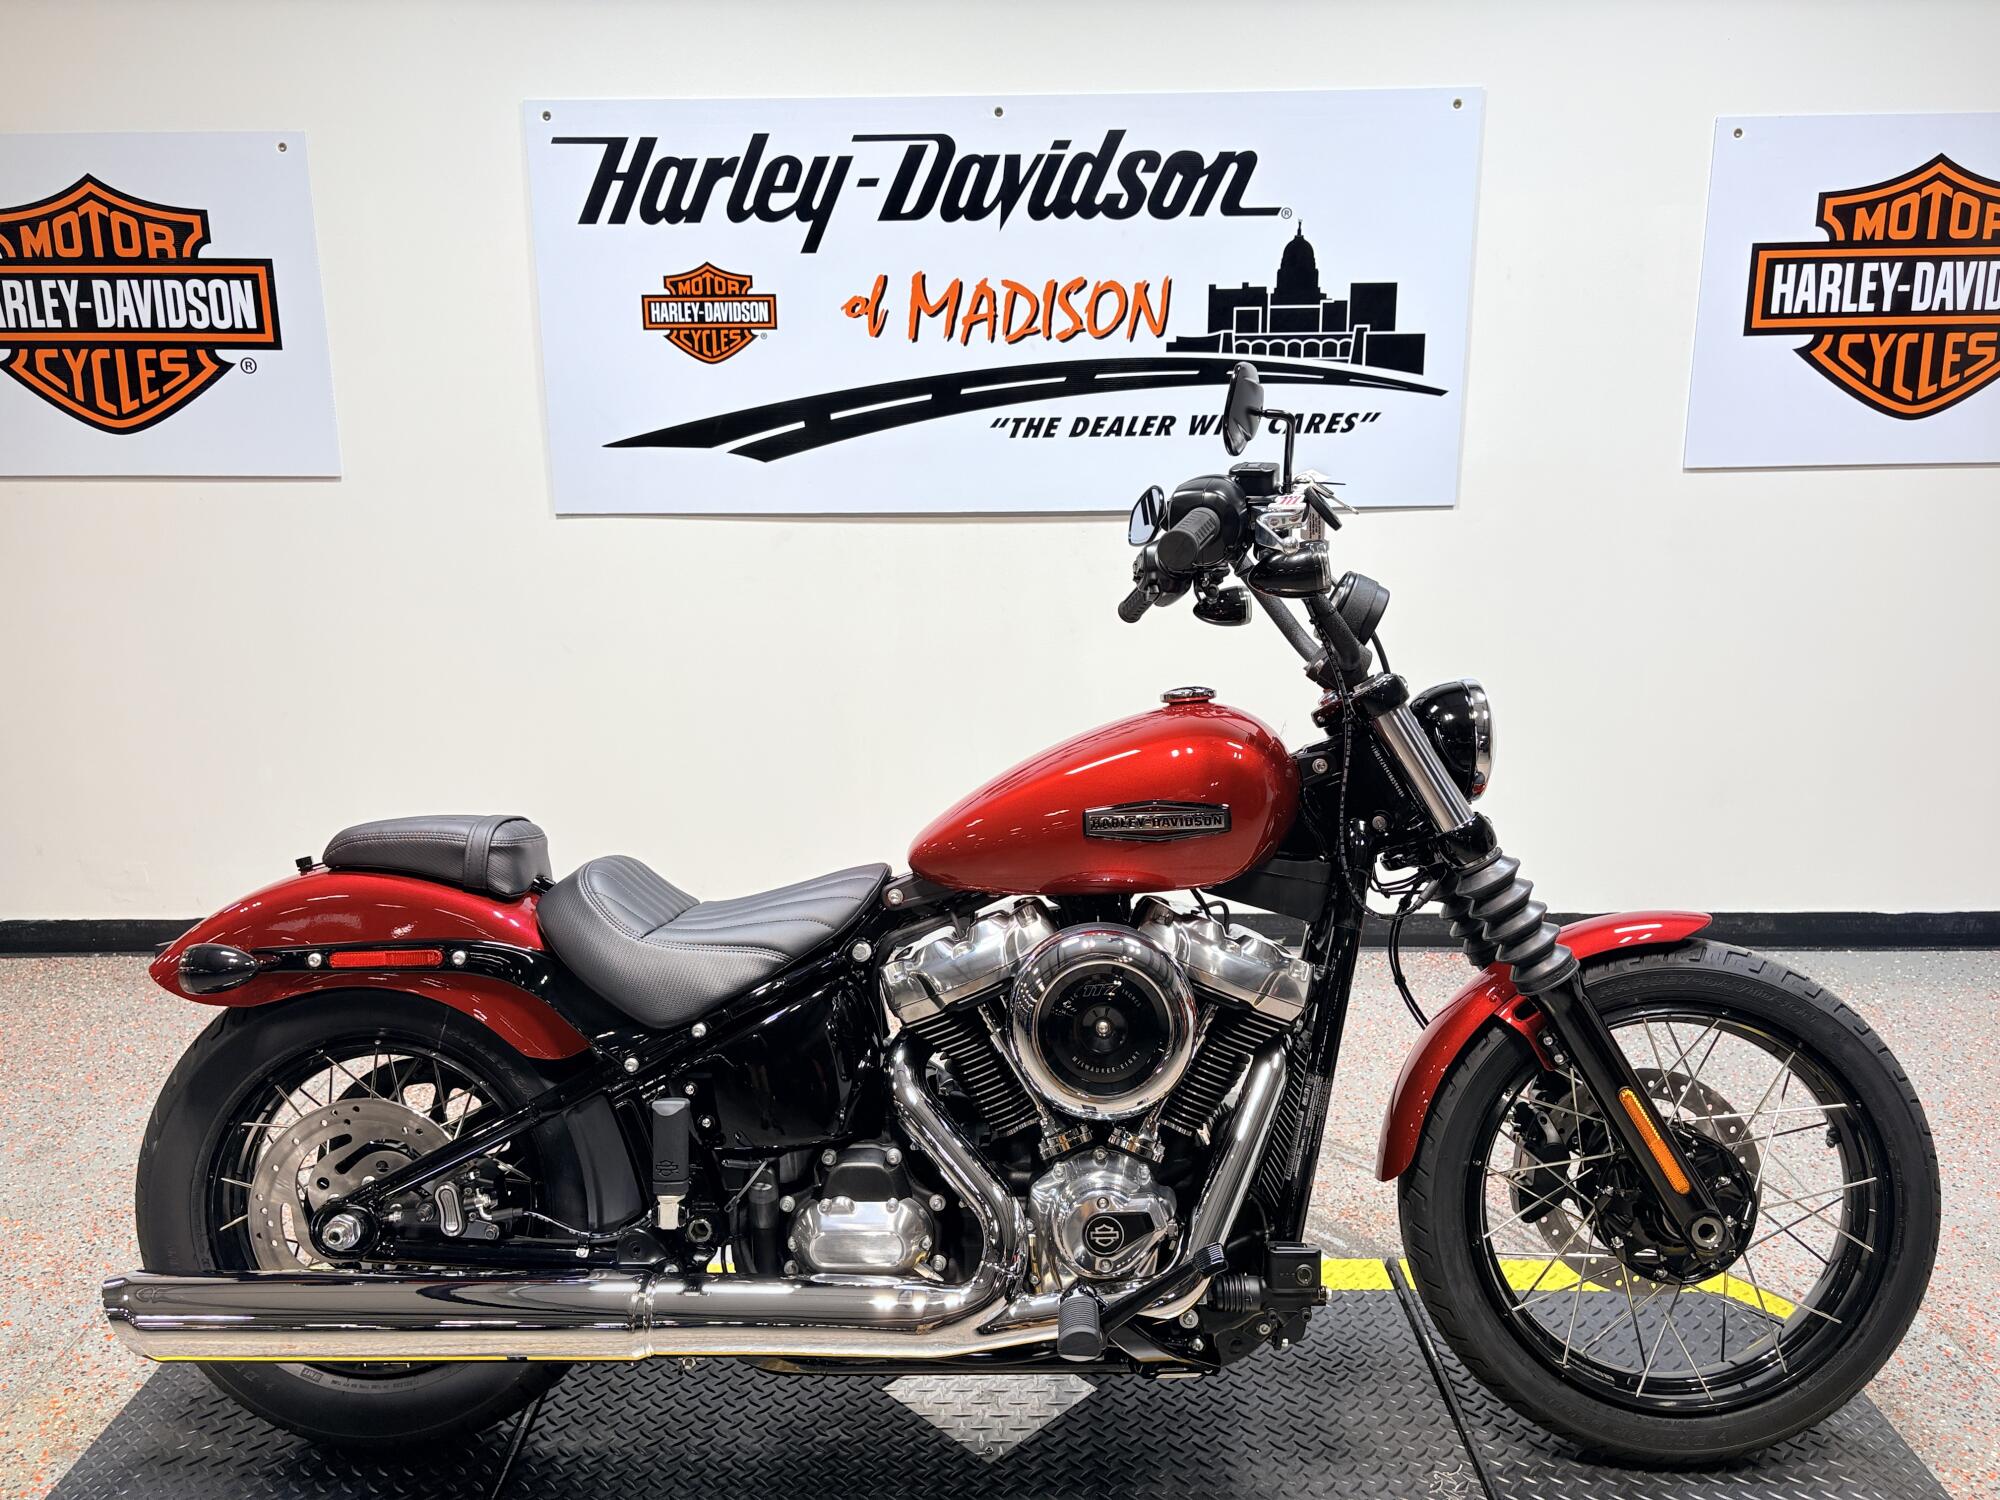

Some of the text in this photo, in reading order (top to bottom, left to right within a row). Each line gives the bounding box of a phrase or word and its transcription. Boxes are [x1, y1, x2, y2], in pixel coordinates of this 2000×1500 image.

[551, 130, 1281, 253] Harley-Davidson
[20, 200, 176, 258] MOTOR
[678, 272, 740, 295] MOTOR
[0, 279, 258, 329] RLEY-DAVIDSON
[651, 301, 769, 323] HARLEY-DAVIDSON
[841, 270, 1172, 346] of MADISON
[680, 329, 741, 356] CYCLES
[35, 349, 190, 416] CYCLES
[1838, 332, 1997, 401] CYCLES
[1068, 415, 1176, 438] DEALER
[1089, 813, 1223, 831] HARLEY-DAVIDSON
[1072, 1050, 1141, 1074] MILWAUKEE-EIGHT
